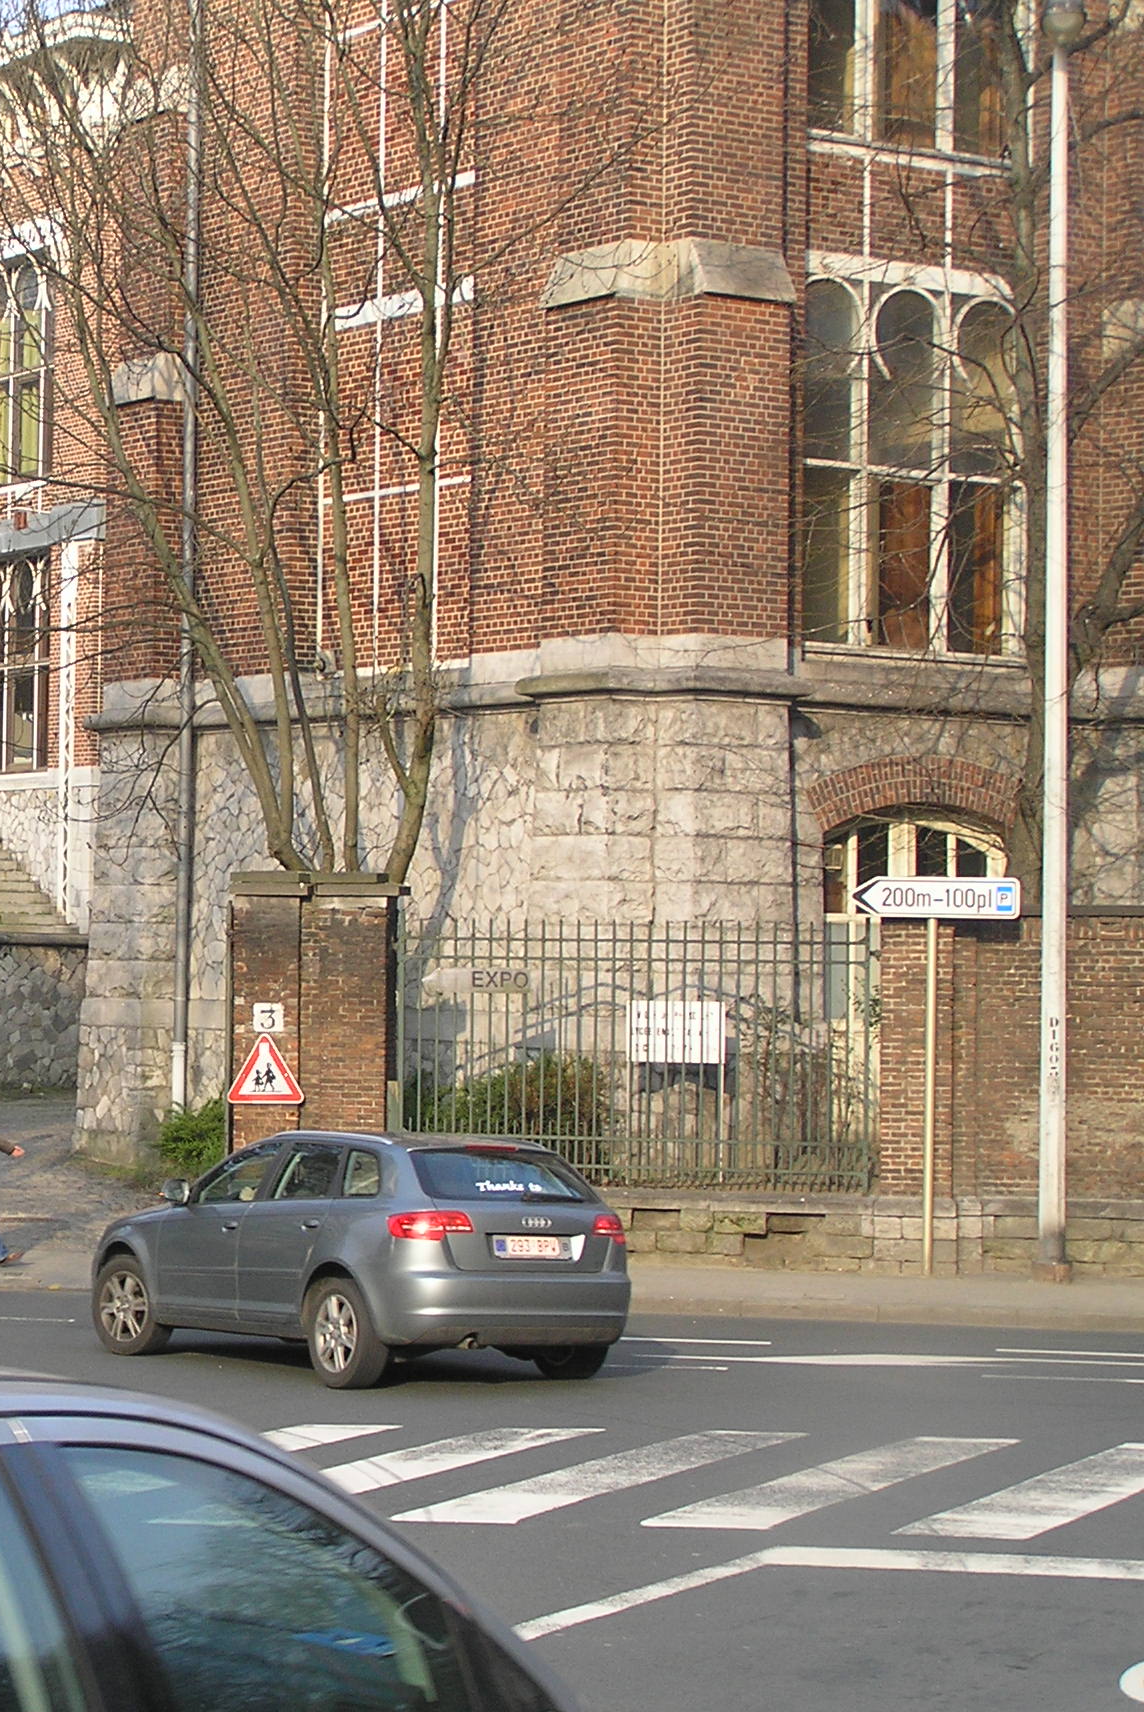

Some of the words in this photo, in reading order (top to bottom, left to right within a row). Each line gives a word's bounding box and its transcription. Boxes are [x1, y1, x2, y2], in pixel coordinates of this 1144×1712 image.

[882, 887, 992, 913] 200m-100pl
[472, 970, 529, 989] EXPO
[260, 1008, 275, 1029] 3
[475, 1180, 524, 1192] Thanks
[528, 1182, 542, 1192] to
